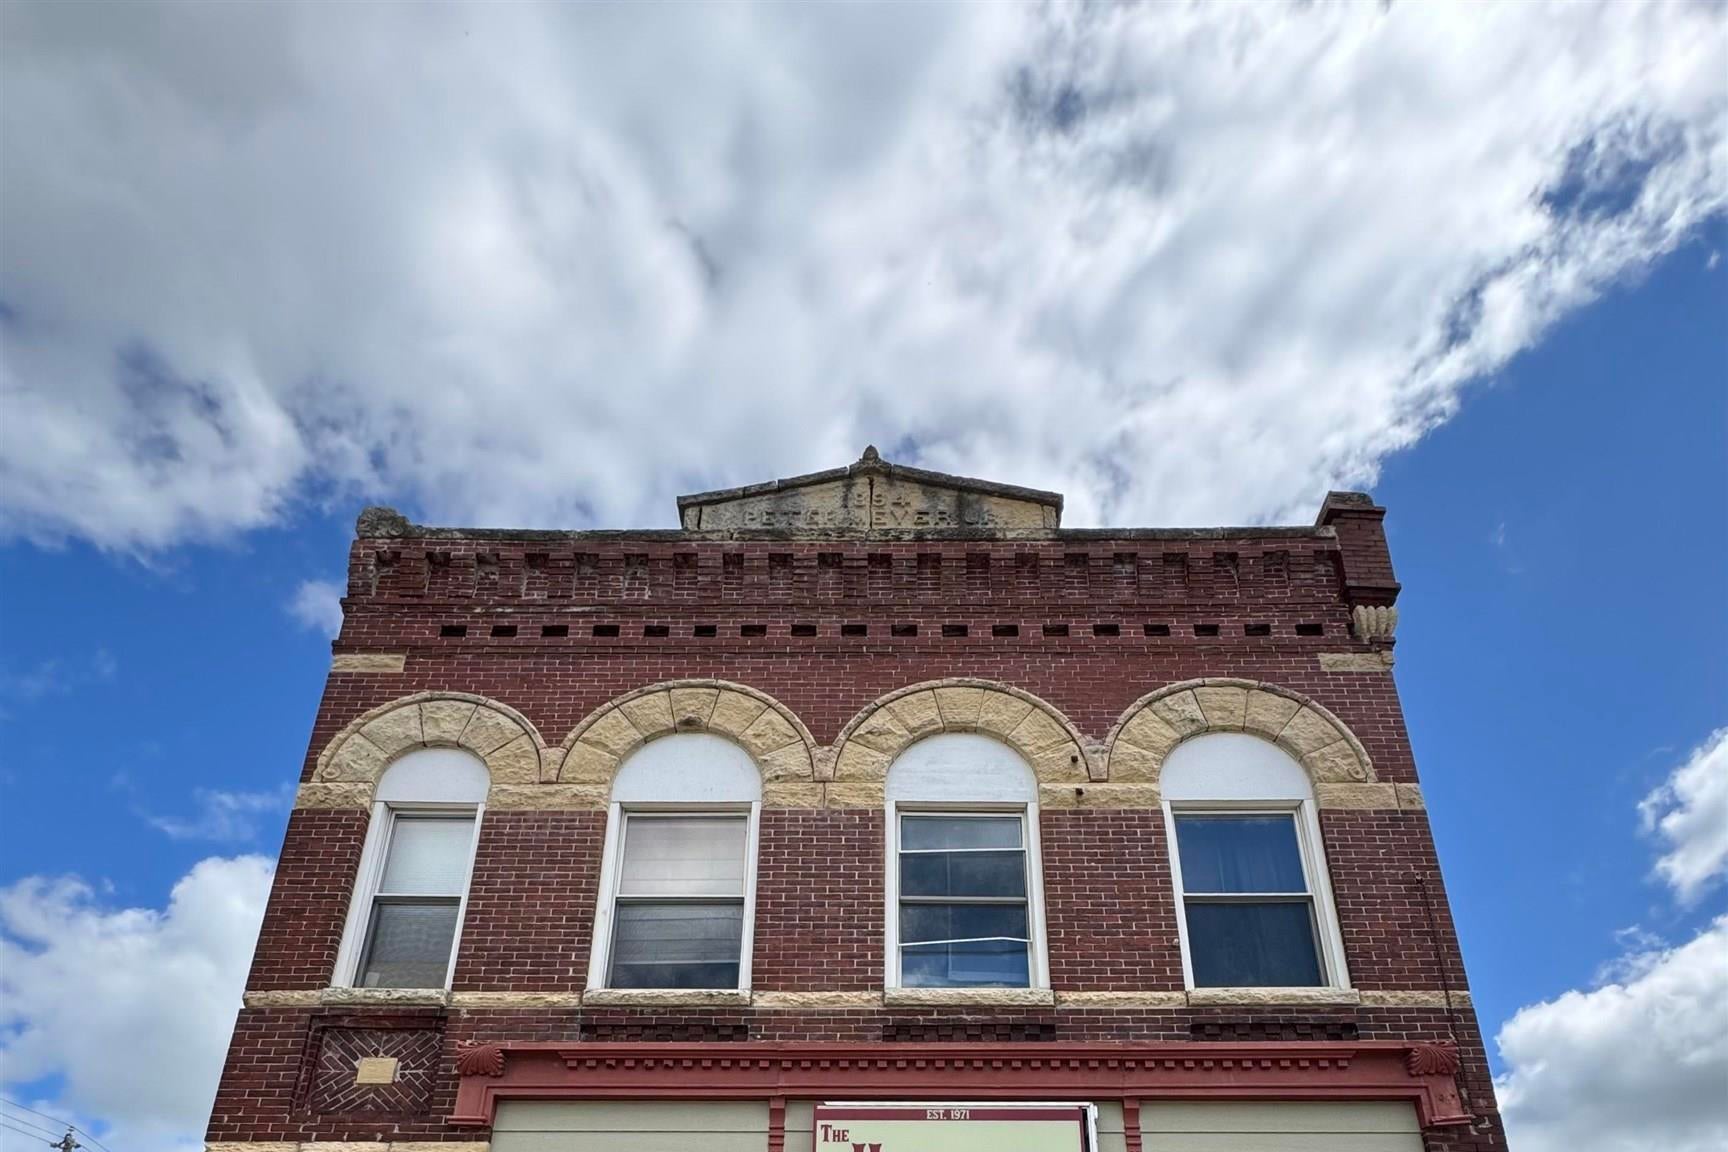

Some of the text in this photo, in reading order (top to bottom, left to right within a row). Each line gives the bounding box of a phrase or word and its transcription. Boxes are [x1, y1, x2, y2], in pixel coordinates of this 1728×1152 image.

[926, 1109, 970, 1120] EST. 1971
[820, 1124, 850, 1142] THE
